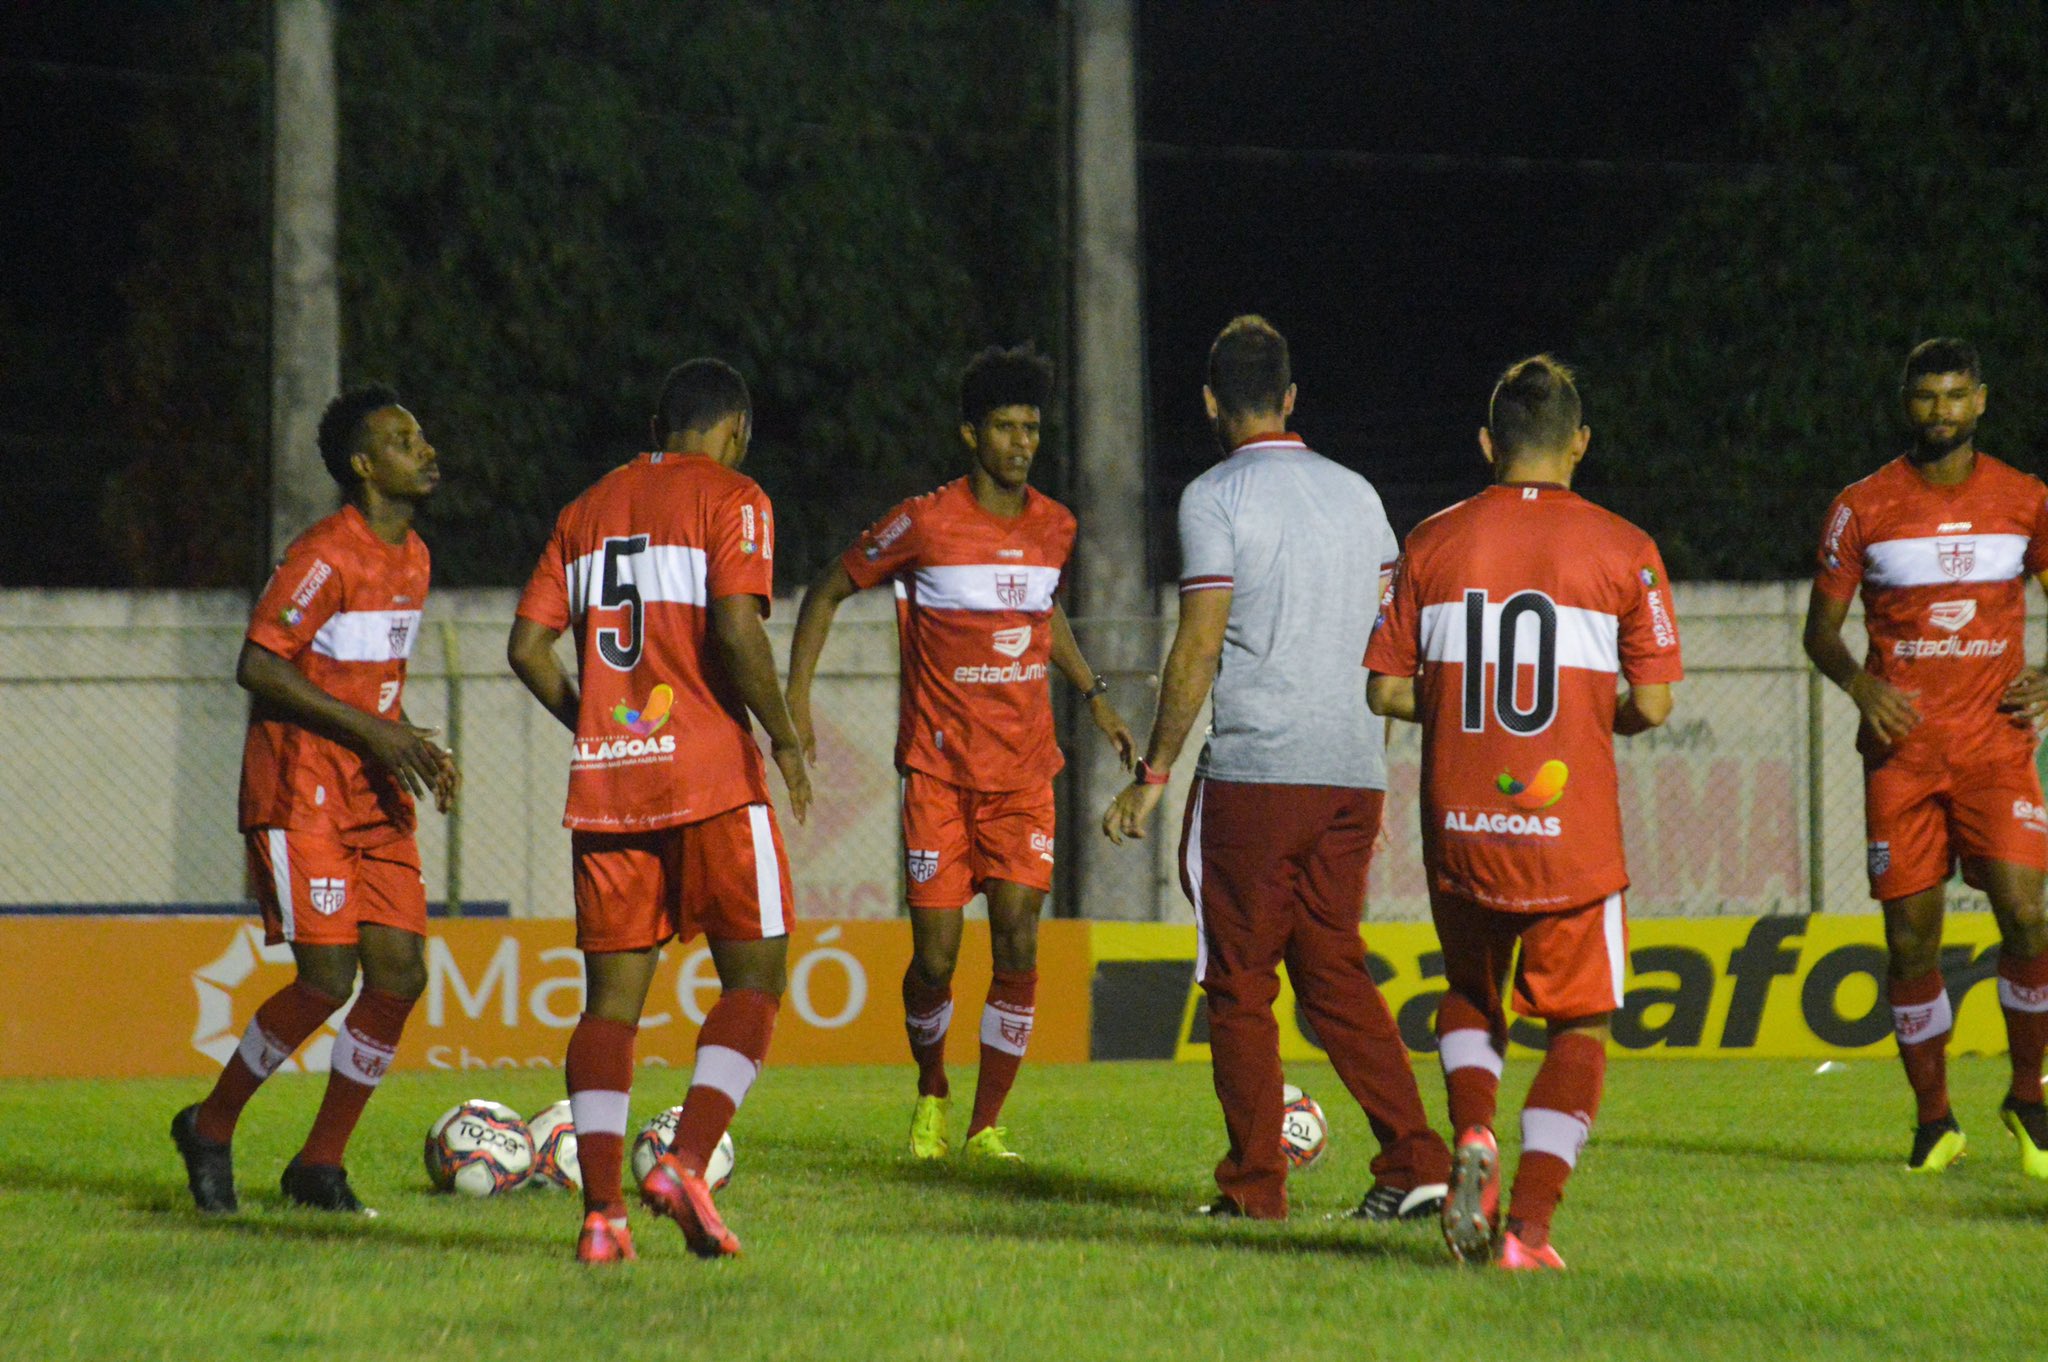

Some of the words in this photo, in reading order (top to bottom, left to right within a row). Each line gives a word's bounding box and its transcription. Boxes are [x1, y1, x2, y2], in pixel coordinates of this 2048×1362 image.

[596, 533, 650, 672] 5
[1462, 588, 1560, 737] 10
[571, 735, 677, 761] ALAGOAS
[1444, 811, 1562, 837] ALAGOAS
[909, 860, 937, 878] CRB
[426, 926, 868, 1029] Maeó
